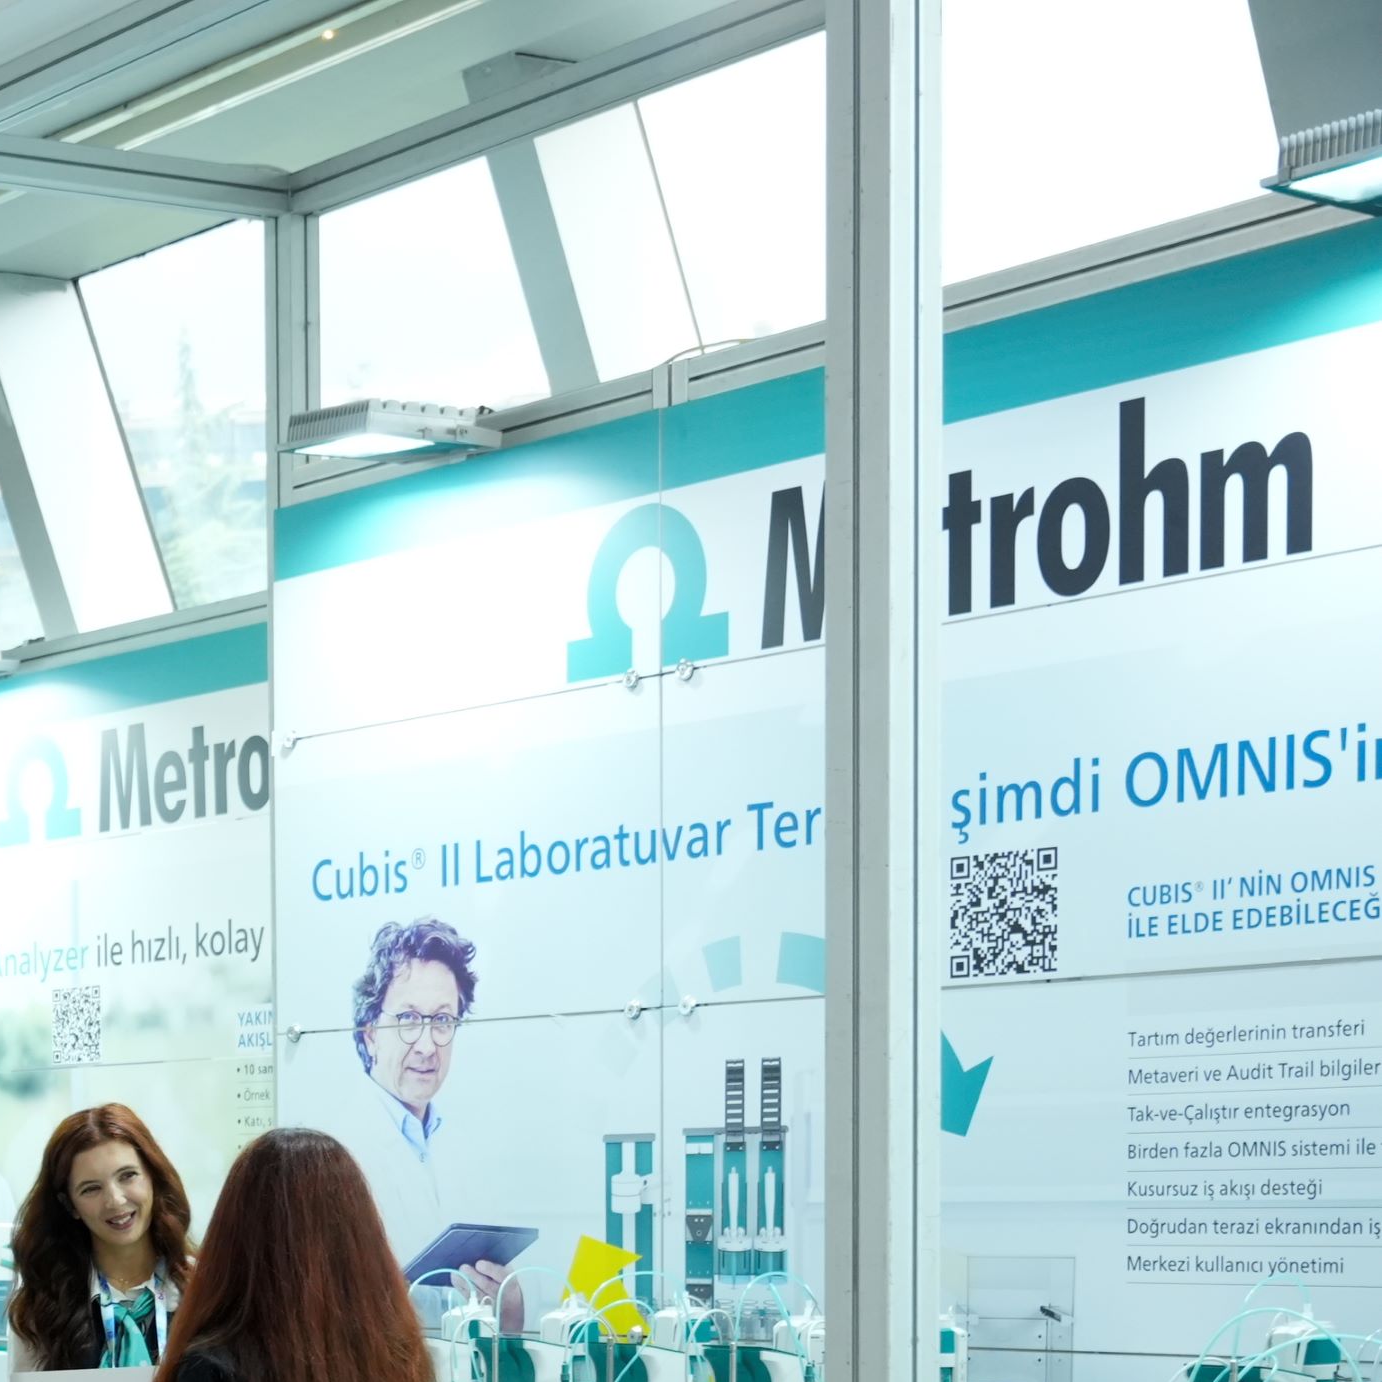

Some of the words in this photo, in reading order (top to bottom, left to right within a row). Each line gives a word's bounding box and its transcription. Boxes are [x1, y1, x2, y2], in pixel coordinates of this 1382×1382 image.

[761, 397, 1313, 650] Mtrohm
[475, 818, 731, 884] Laboratuvar
[950, 757, 1100, 844] şimdi
[1290, 864, 1376, 893] OMNIS
[1127, 912, 1159, 939] İLE
[1166, 910, 1223, 936] ELDE
[1231, 890, 1380, 930] EDEBİLECEĞ
[96, 933, 124, 968] ile
[195, 918, 266, 962] kolay
[1128, 1031, 1179, 1048] Tartım
[1184, 1024, 1286, 1048] değerlerinin
[1291, 1019, 1365, 1040] transferi
[1128, 1066, 1199, 1085] Metaveri
[1203, 1069, 1222, 1082] ve
[1226, 1063, 1273, 1081] Audit
[1278, 1060, 1314, 1079] Trail
[1128, 1103, 1239, 1125] Tak-ve-Çalıştır
[1243, 1102, 1351, 1122] entegrasyon
[1127, 1142, 1179, 1159] Birden
[1183, 1140, 1223, 1159] fazla
[1227, 1140, 1287, 1158] OMNIS
[1290, 1138, 1351, 1157] sistemi
[1355, 1137, 1377, 1156] ile
[1127, 1180, 1199, 1197] Kusursuz
[1203, 1180, 1215, 1201] iş
[1218, 1178, 1255, 1201] akışı
[1260, 1178, 1323, 1200] desteği
[1127, 1218, 1208, 1239] Doğrudan
[1212, 1217, 1260, 1235] terazi
[1264, 1217, 1363, 1236] ekranından
[1127, 1254, 1191, 1273] Merkezi
[1195, 1255, 1264, 1274] kullanıcı
[1267, 1257, 1345, 1278] yönetimi
